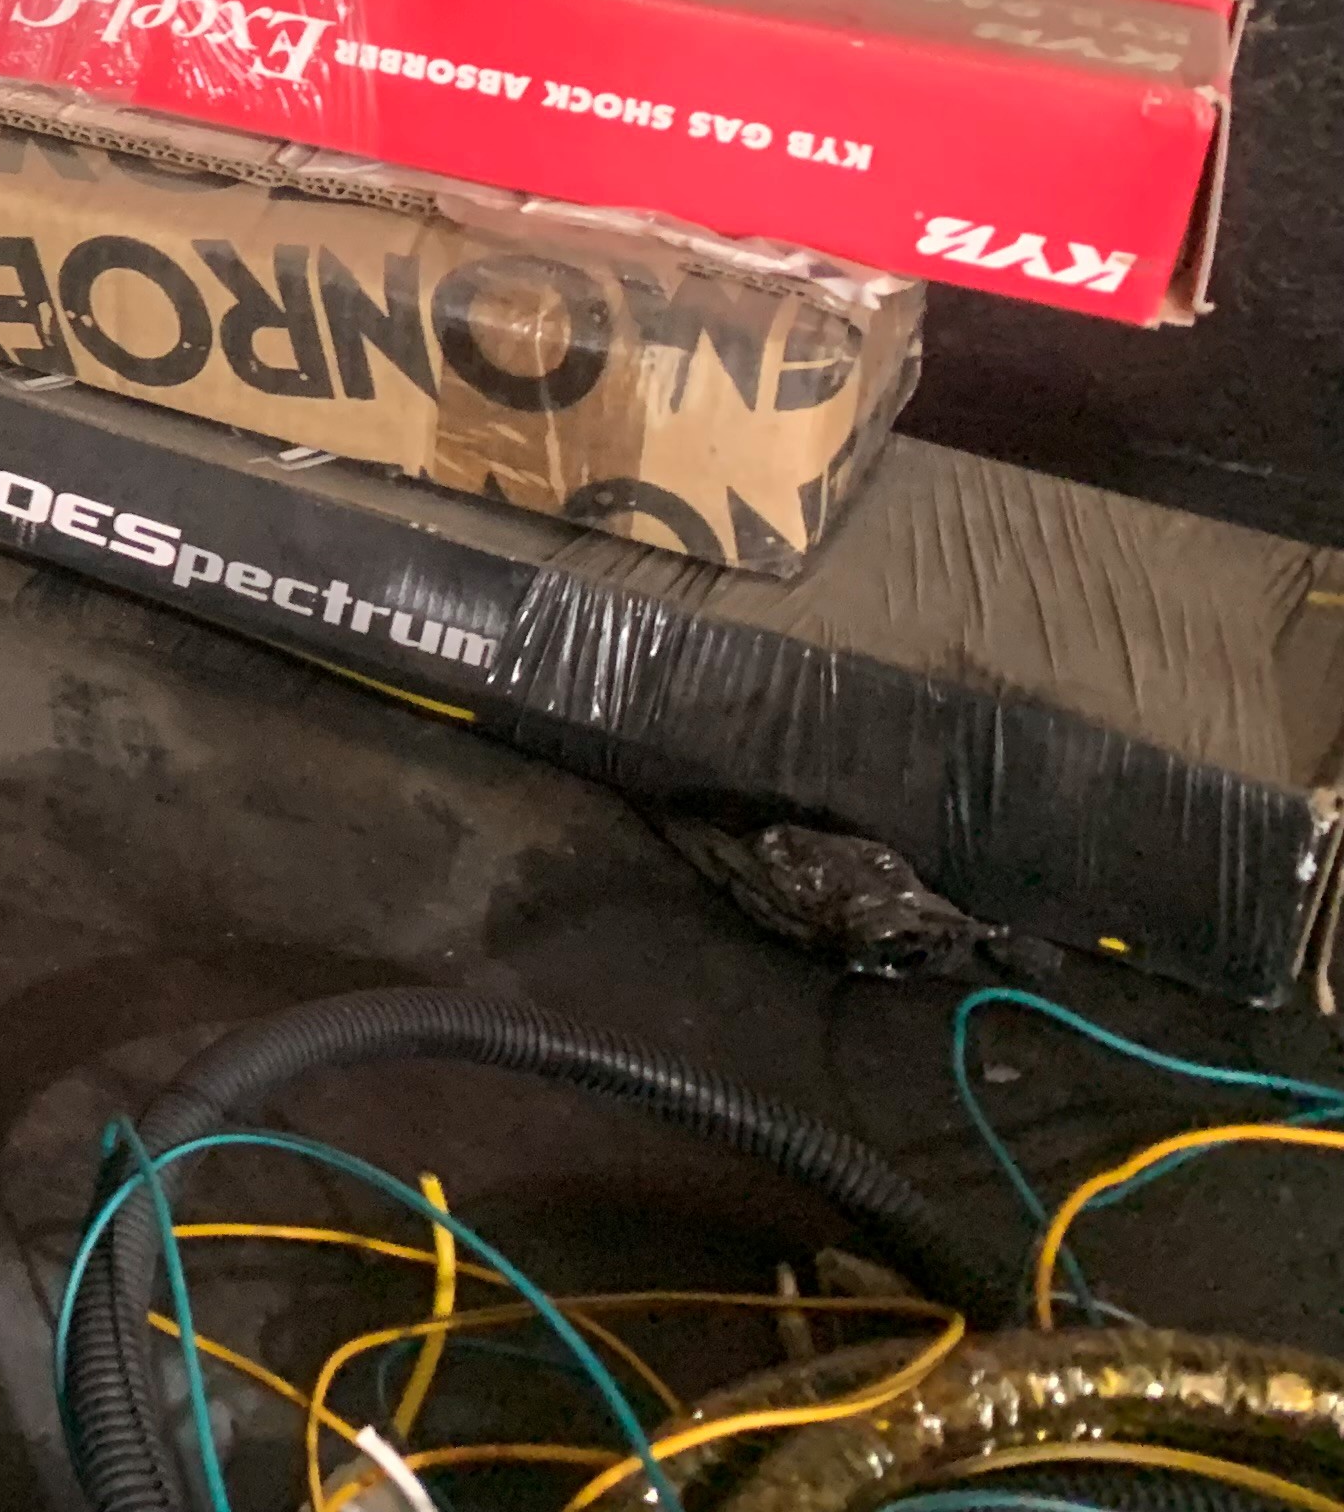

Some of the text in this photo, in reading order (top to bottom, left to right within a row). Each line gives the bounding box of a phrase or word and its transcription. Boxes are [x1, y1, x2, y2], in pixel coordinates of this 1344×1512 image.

[334, 37, 874, 172] KYB GAS SHOCK ABSORBER
[914, 214, 1139, 294] KYB
